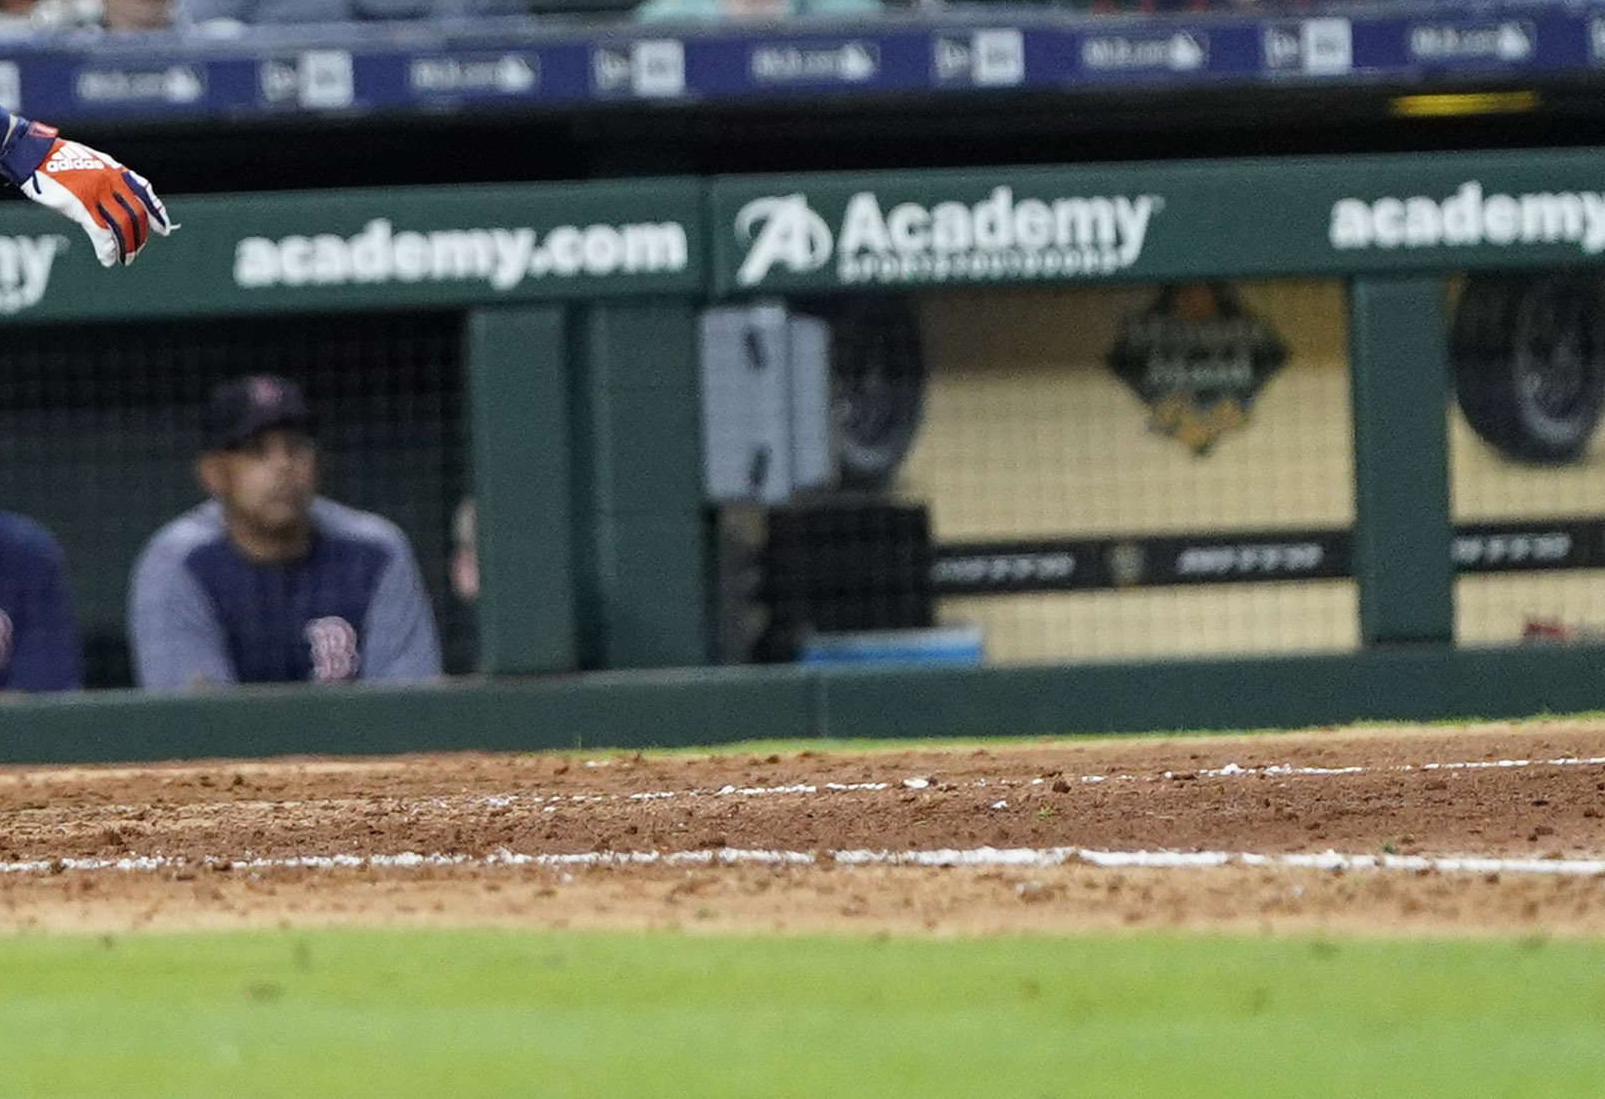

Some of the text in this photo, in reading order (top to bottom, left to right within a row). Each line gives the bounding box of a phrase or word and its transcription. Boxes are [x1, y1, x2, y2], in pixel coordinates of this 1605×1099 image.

[46, 159, 105, 173] adidas
[233, 218, 688, 290] academy.com
[838, 185, 1154, 267] Academy
